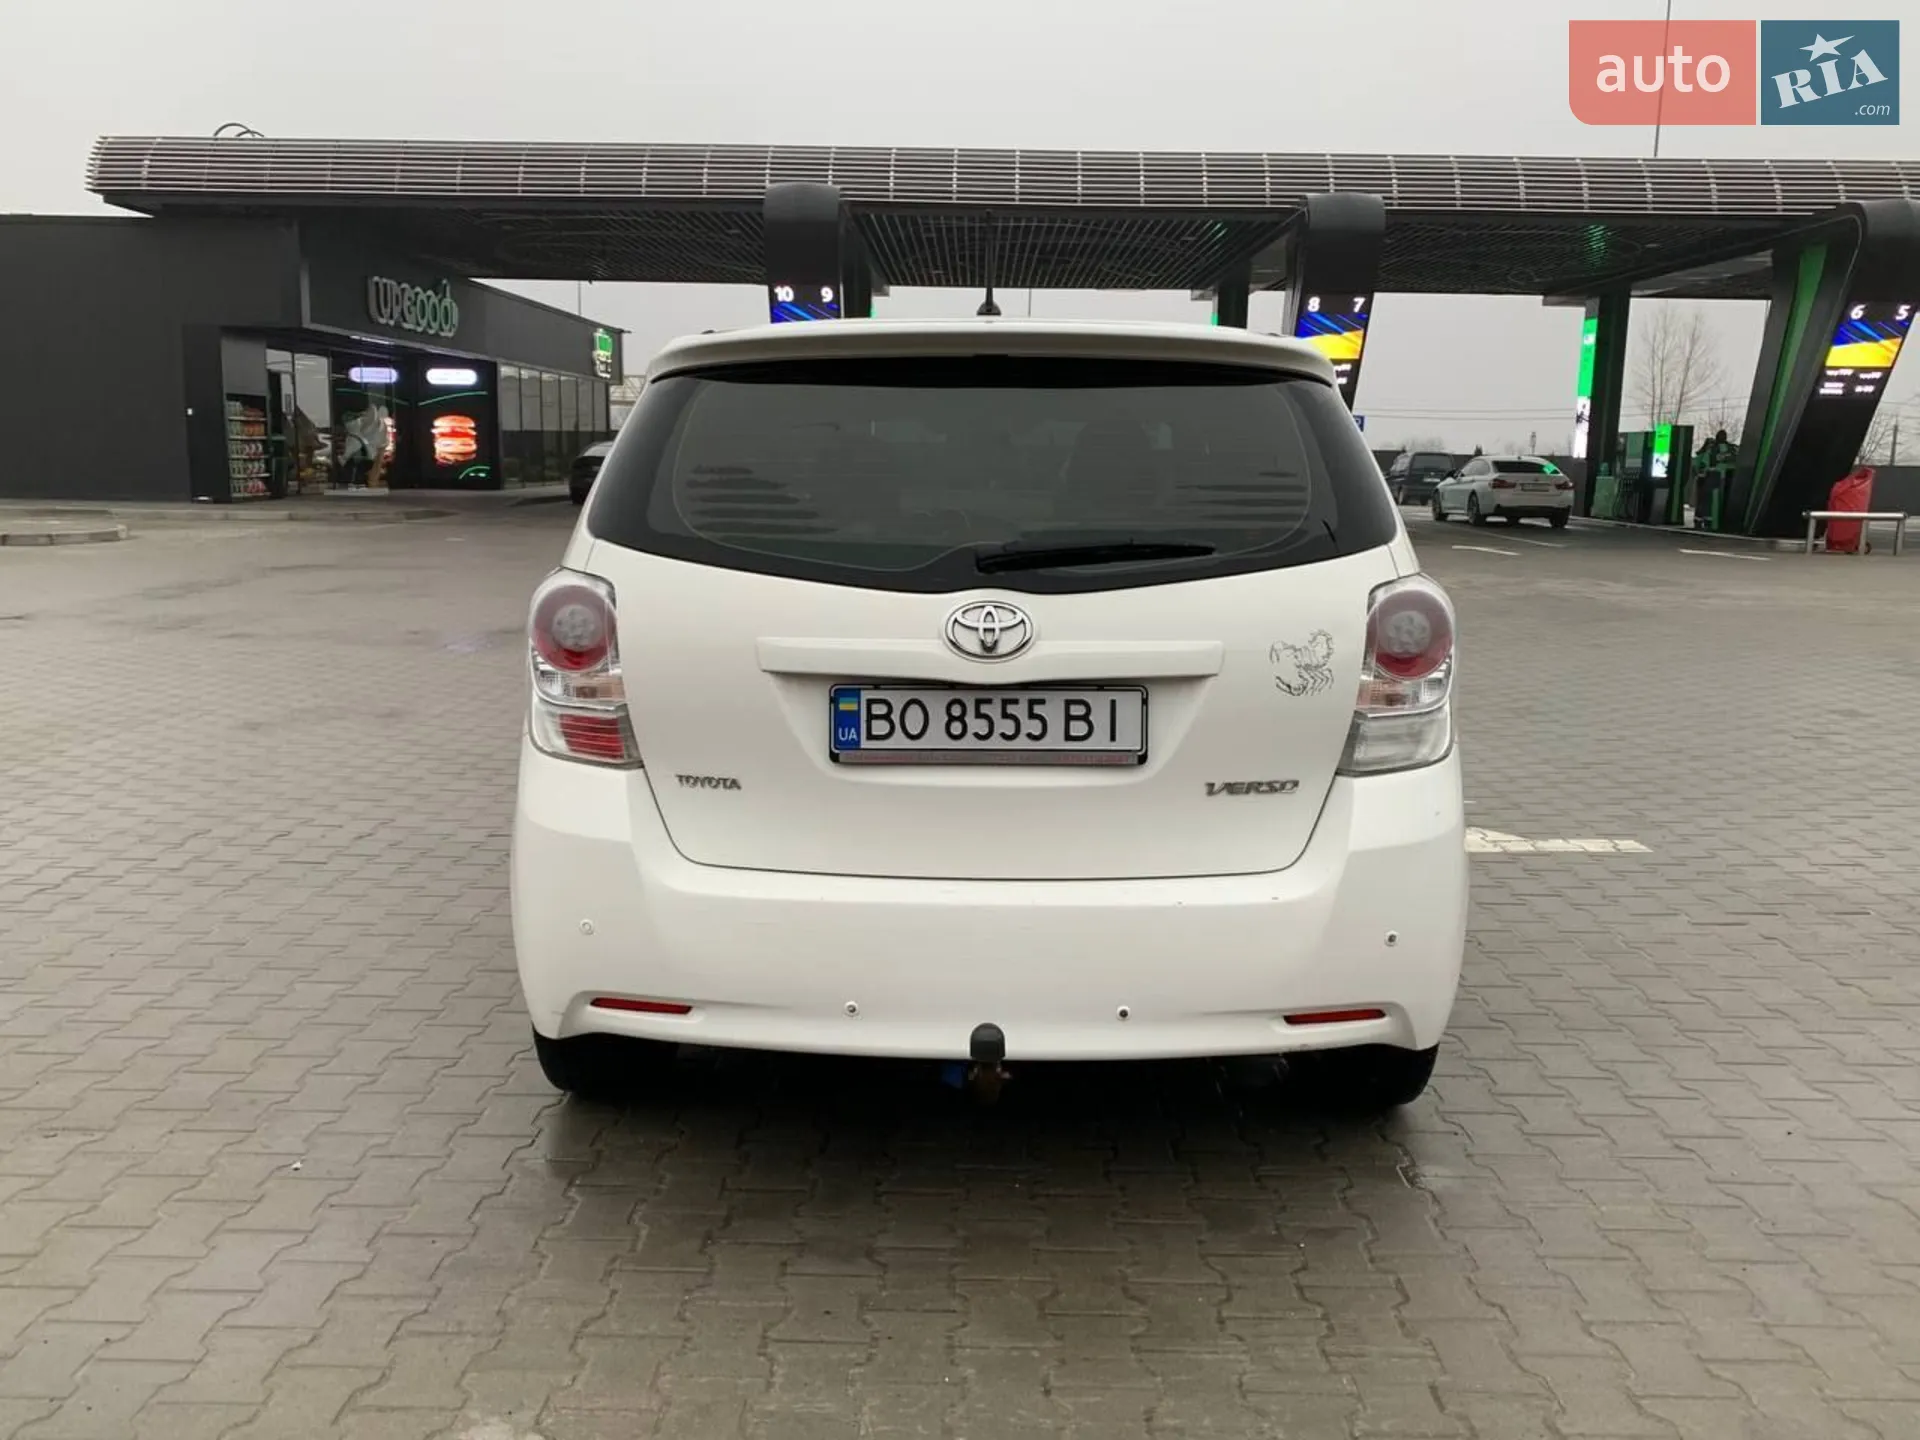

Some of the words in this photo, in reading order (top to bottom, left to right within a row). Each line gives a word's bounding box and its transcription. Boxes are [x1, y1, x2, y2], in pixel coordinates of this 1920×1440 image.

[774, 285, 794, 302] 10
[821, 286, 833, 303] 9
[1308, 297, 1321, 312] 8
[1353, 297, 1366, 313] 7
[1850, 304, 1866, 320] 6
[1895, 304, 1911, 321] 5
[865, 697, 930, 741] BO
[944, 697, 1049, 742] 8555
[1063, 698, 1117, 743] BI
[838, 727, 859, 742] UA
[675, 773, 742, 790] TOYOTA
[1204, 779, 1300, 797] VERSO
